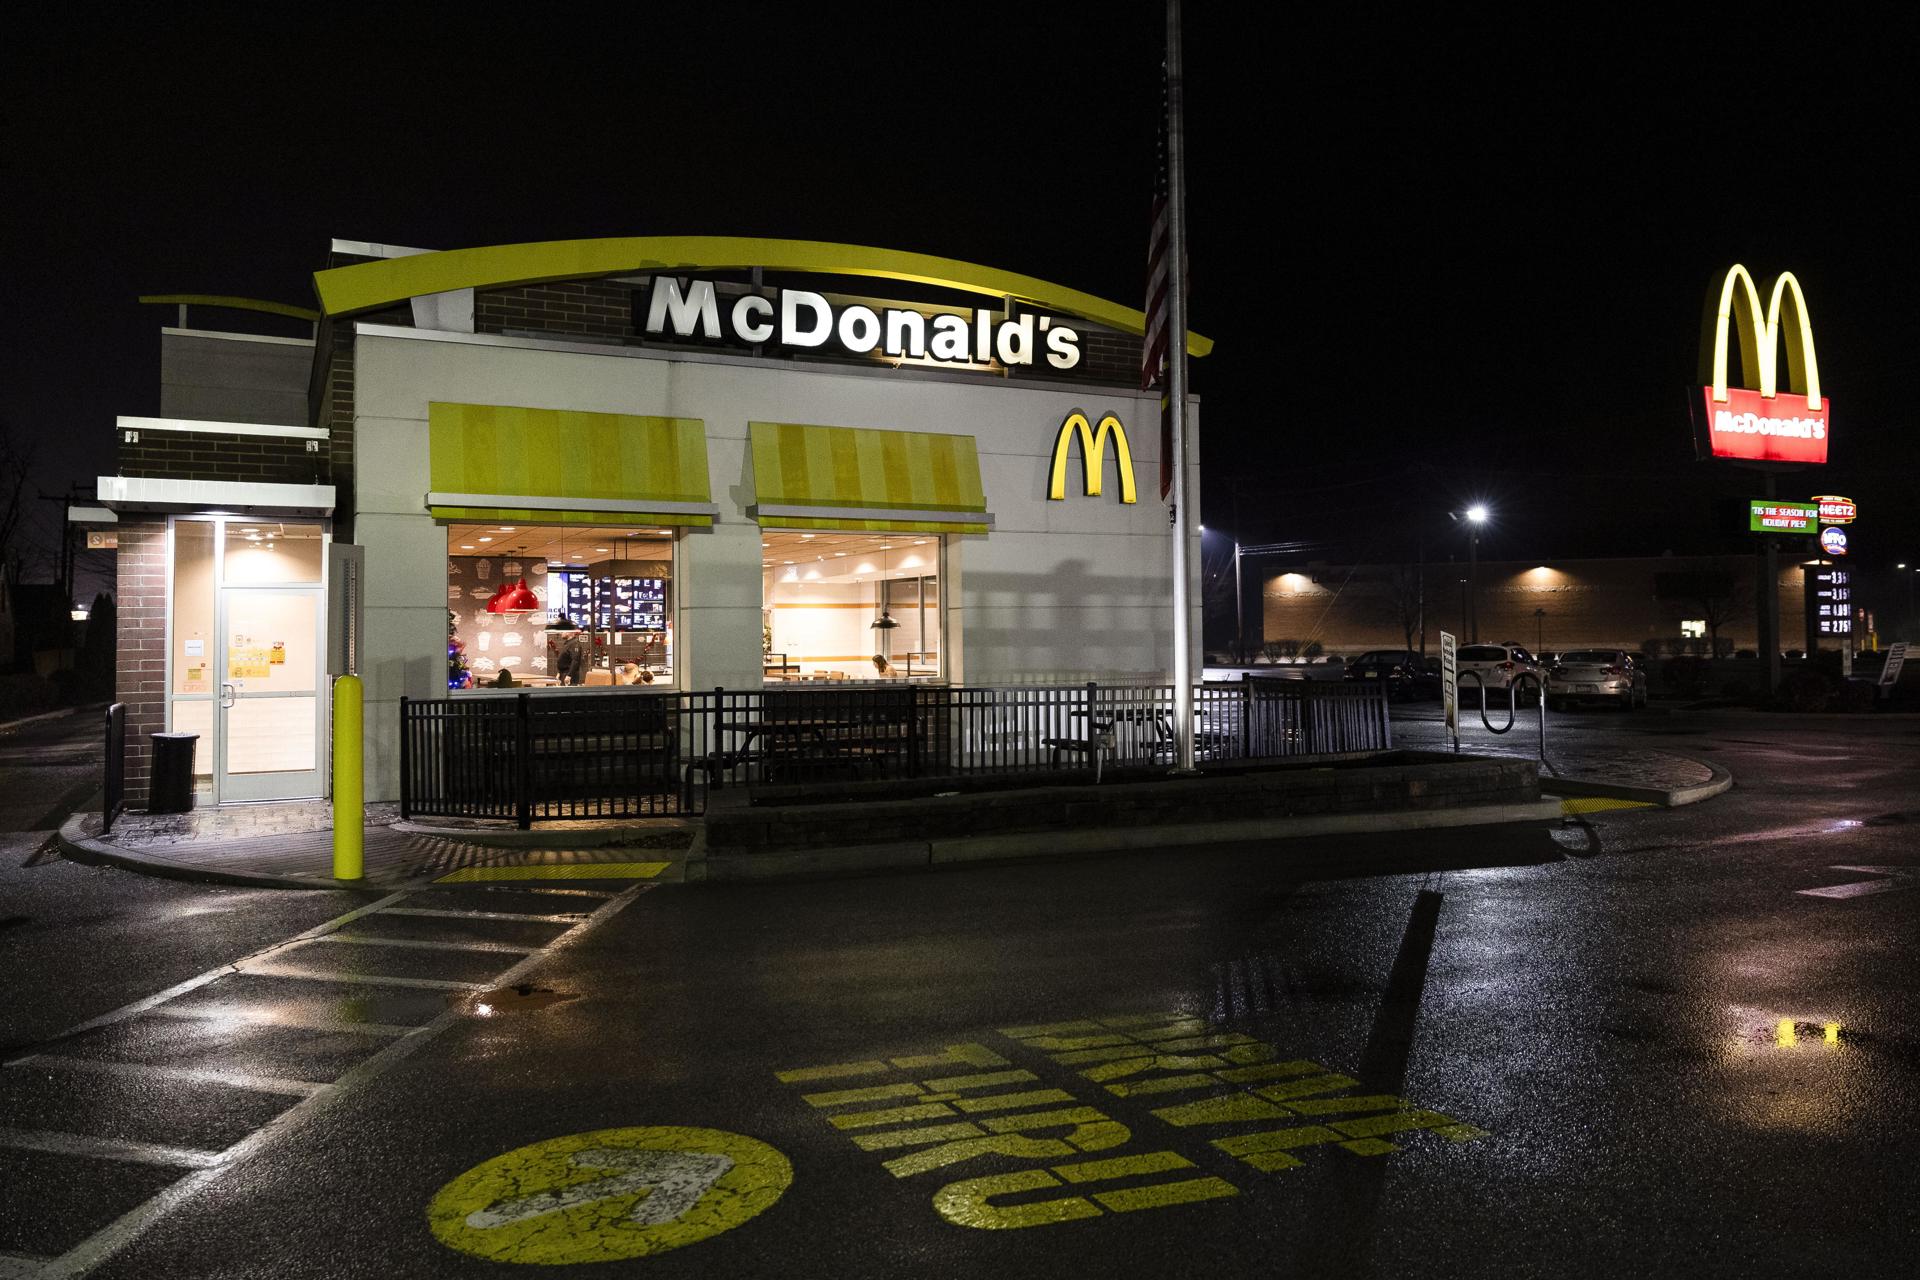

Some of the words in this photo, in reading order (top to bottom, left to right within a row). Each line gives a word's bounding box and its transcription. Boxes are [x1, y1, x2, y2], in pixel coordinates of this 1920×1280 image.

[645, 275, 1081, 370] McDonald's
[1714, 410, 1826, 440] McDonald's
[1765, 507, 1778, 515] THE
[1779, 508, 1804, 517] SEASON
[1819, 504, 1854, 516] HEETZ
[773, 1042, 1242, 1231] THRU
